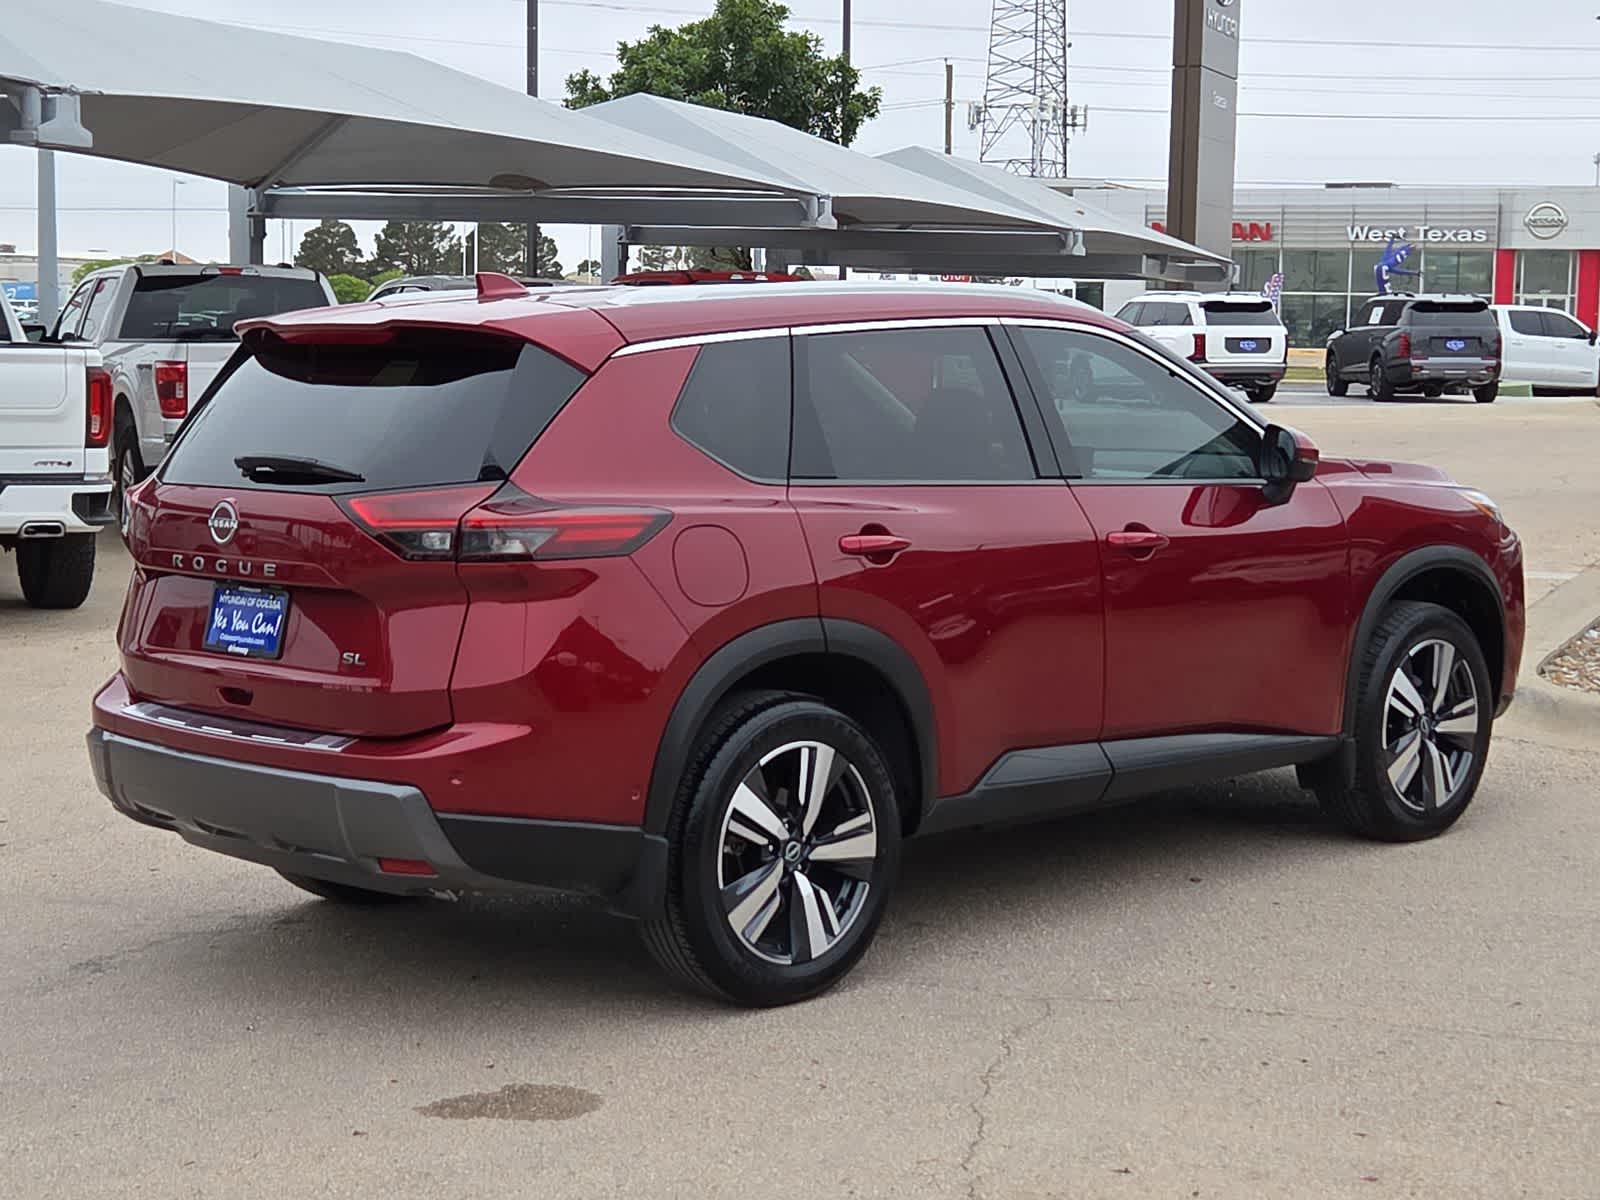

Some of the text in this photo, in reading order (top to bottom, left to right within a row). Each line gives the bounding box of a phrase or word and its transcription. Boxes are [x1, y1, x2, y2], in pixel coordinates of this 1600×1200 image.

[1346, 225, 1488, 242] West Texas
[172, 554, 277, 577] ROGUE
[212, 607, 282, 637] Yes You Can!
[343, 652, 366, 665] SL
